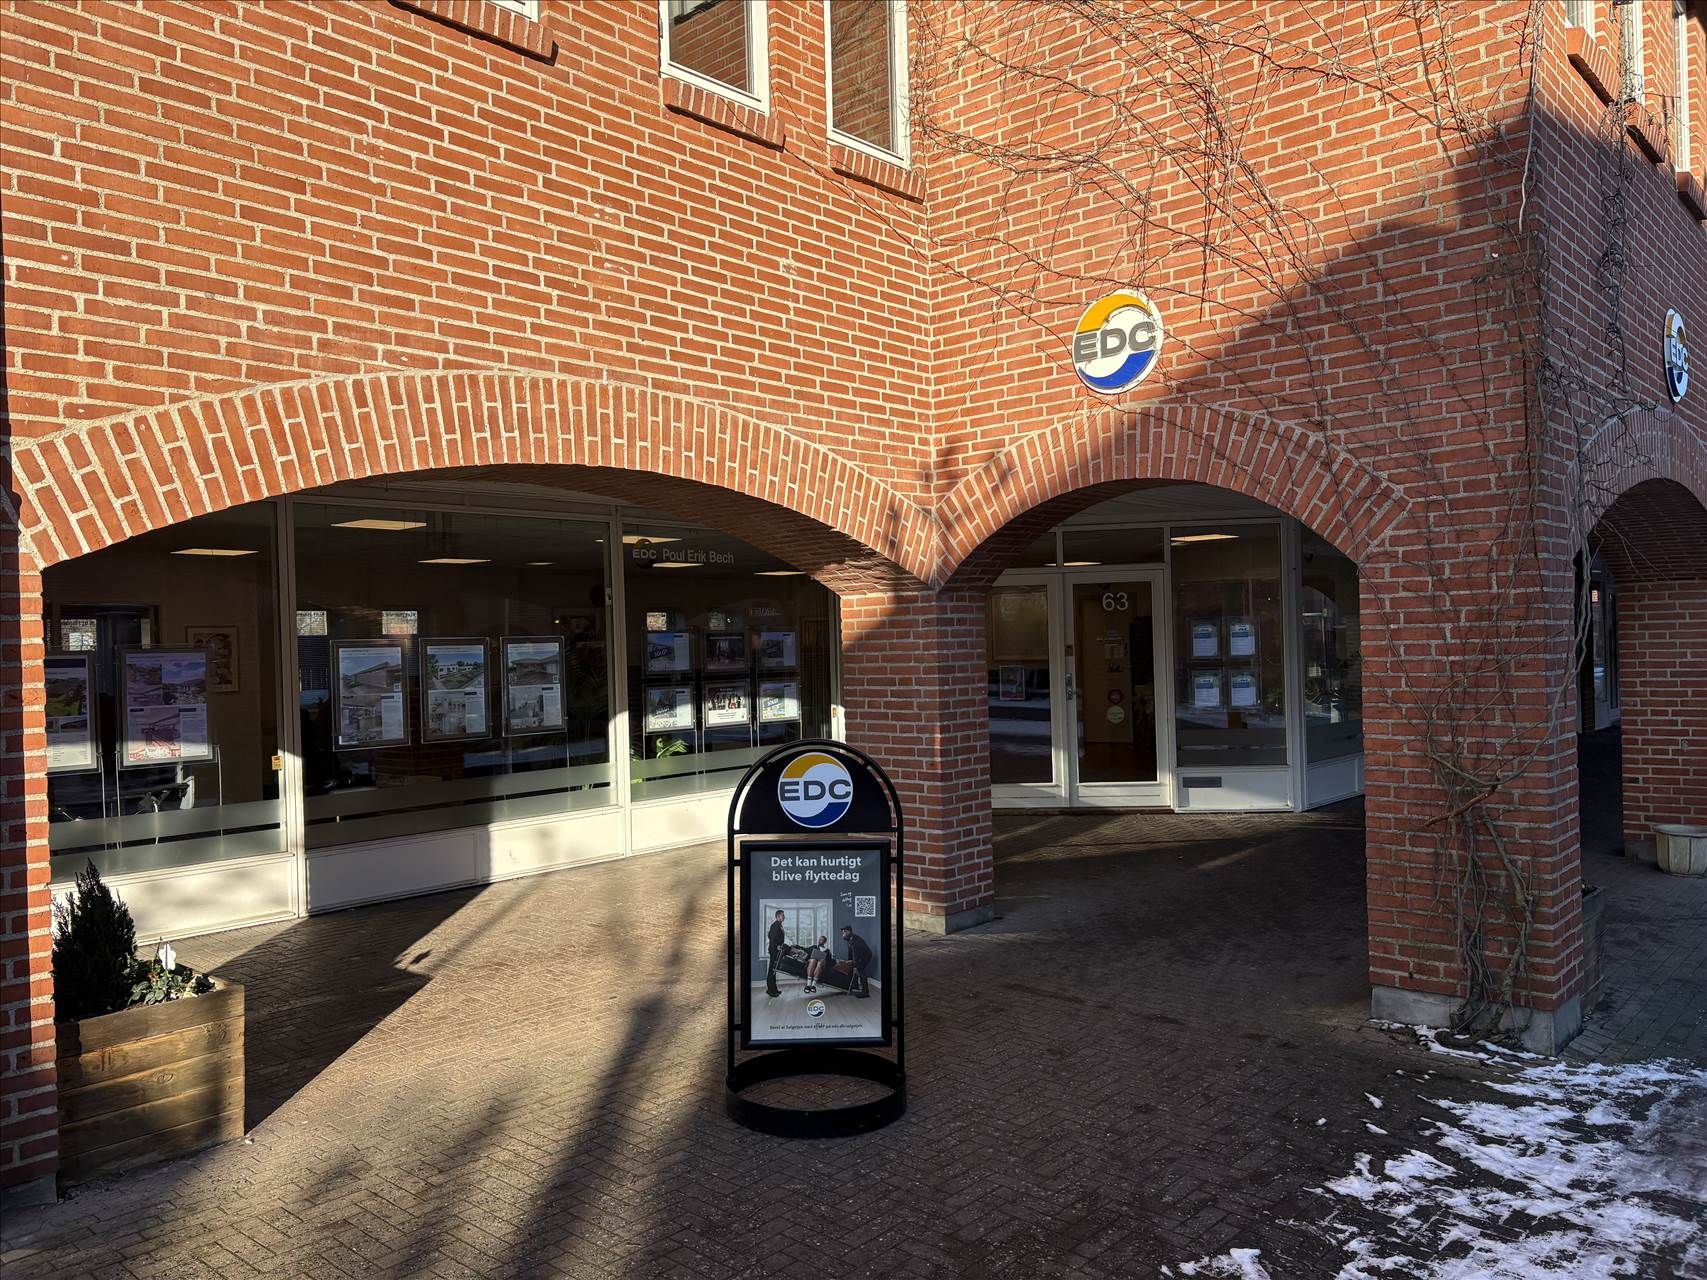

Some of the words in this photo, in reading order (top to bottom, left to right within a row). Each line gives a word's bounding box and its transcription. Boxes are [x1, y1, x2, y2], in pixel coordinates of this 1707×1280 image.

[1073, 321, 1156, 364] EDC
[632, 548, 657, 559] EDC
[662, 548, 685, 561] Poul
[687, 549, 706, 562] Erik
[709, 551, 734, 563] Bech
[1102, 592, 1129, 611] 63
[779, 779, 851, 801] EDC
[771, 857, 792, 867] Det
[795, 857, 817, 867] kan
[820, 856, 862, 869] hurtigt
[772, 870, 802, 881] blive
[805, 869, 860, 883] flyttedag
